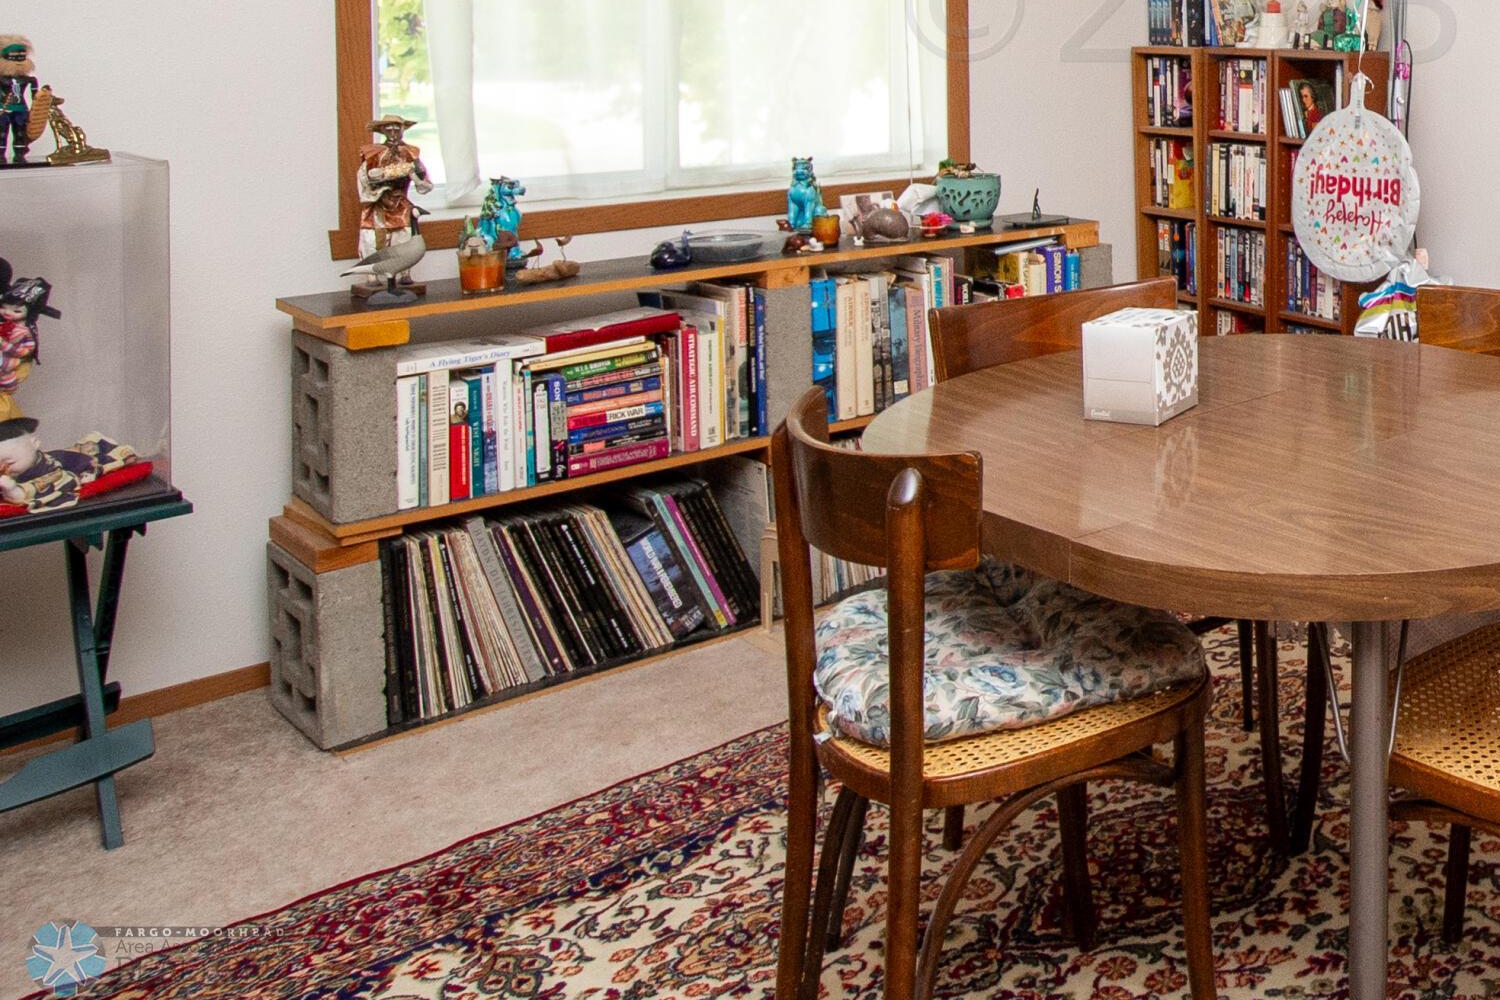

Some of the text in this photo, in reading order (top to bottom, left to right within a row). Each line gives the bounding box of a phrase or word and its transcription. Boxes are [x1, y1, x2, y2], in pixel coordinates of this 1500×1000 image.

[1309, 164, 1401, 207] Birthday!
[1323, 199, 1384, 235] Happy
[1052, 252, 1063, 284] SIMON
[911, 310, 923, 343] Military
[437, 356, 462, 368] Flying
[463, 353, 489, 364] Tiger's
[490, 350, 512, 359] Diary
[687, 333, 696, 377] STRATEGIC
[690, 395, 698, 437] COMMAND
